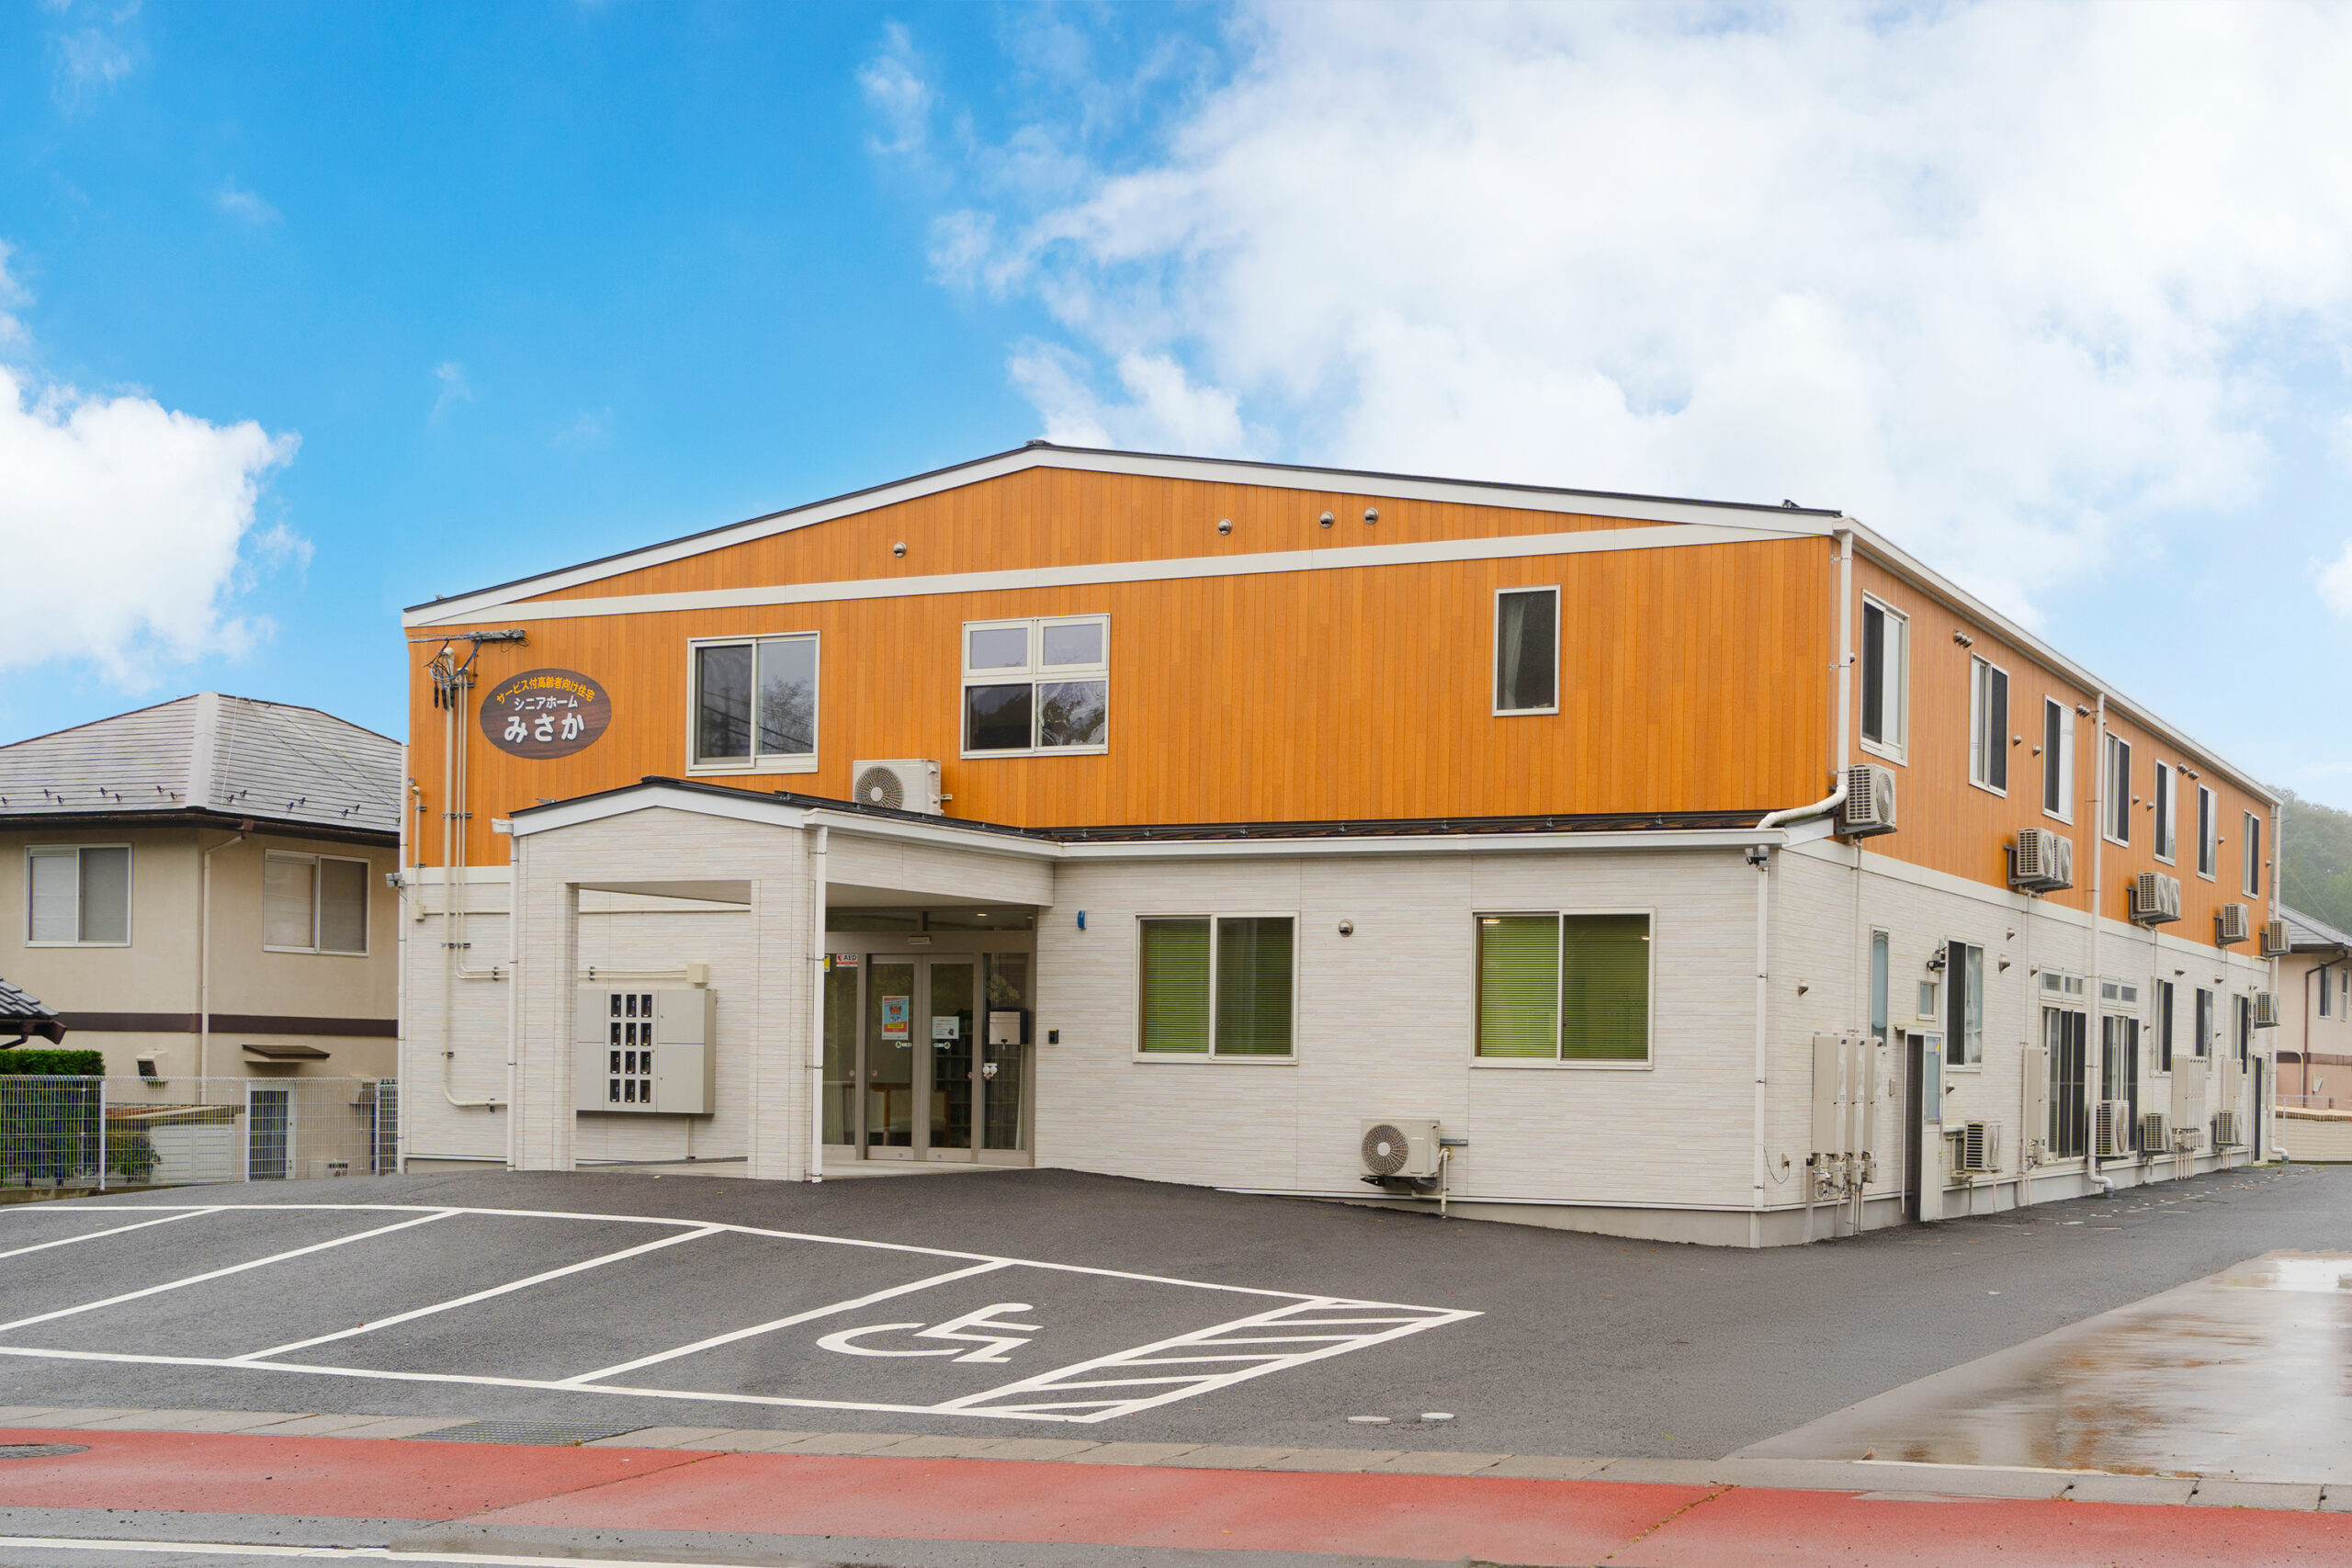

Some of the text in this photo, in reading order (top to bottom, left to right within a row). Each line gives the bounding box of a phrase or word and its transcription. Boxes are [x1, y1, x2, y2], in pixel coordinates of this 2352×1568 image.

[496, 676, 595, 705] サービス付高齢者向け住宅
[514, 695, 578, 711] シニアホーム
[504, 713, 585, 743] みさか
